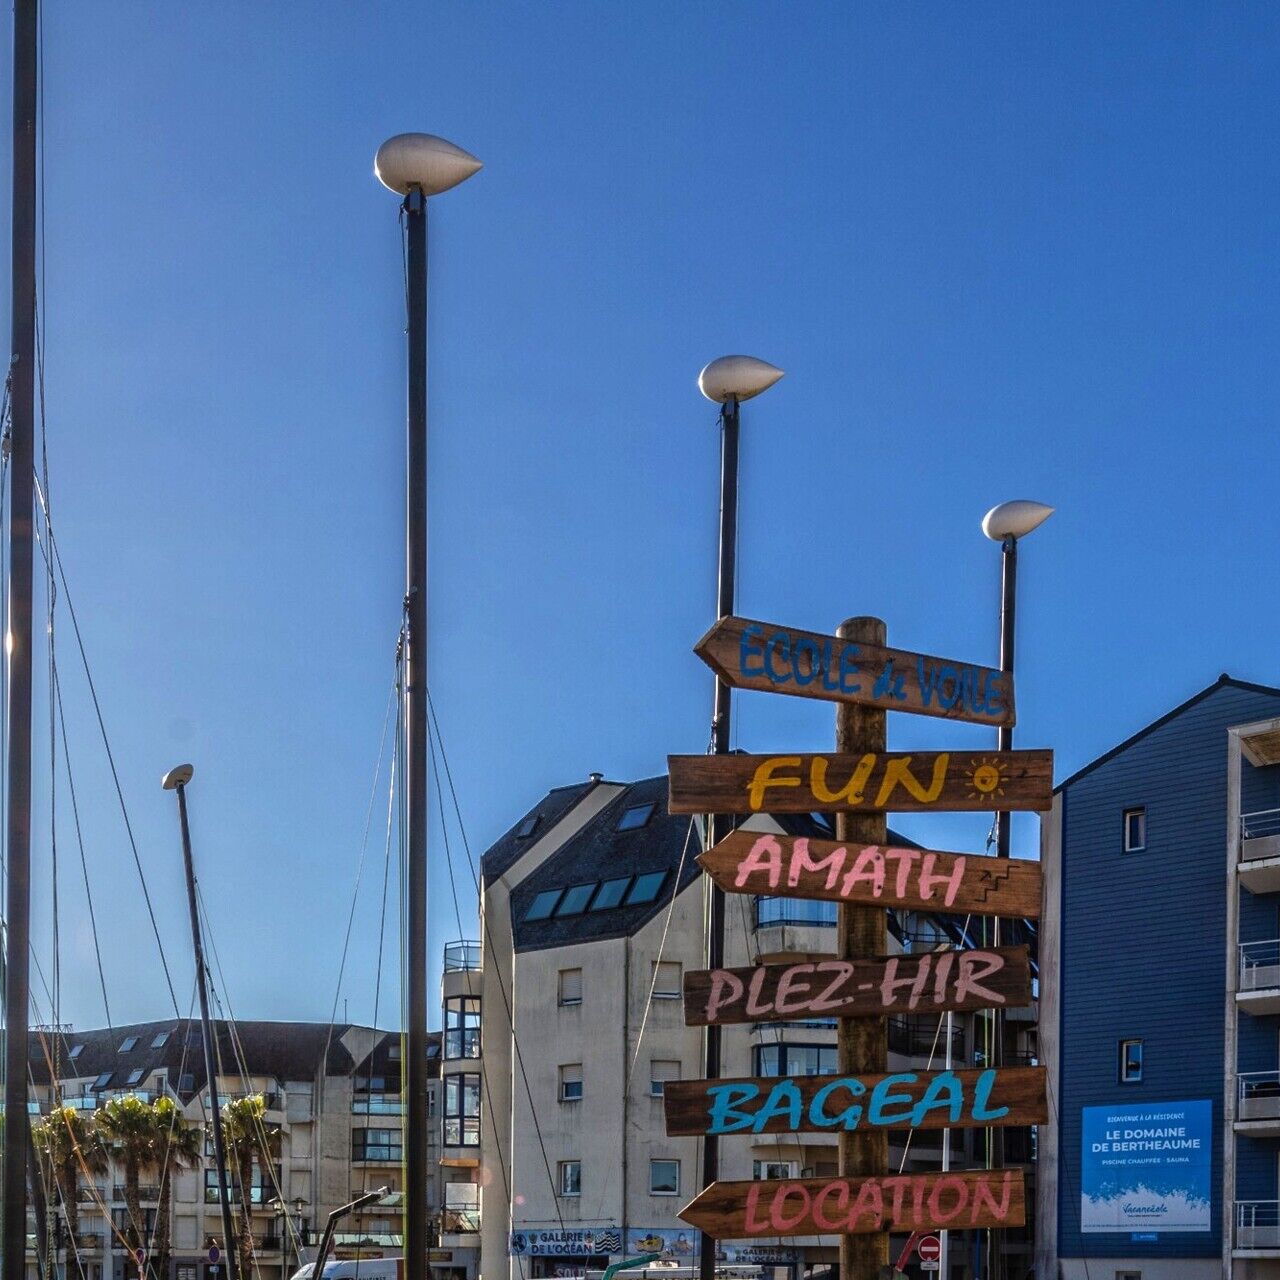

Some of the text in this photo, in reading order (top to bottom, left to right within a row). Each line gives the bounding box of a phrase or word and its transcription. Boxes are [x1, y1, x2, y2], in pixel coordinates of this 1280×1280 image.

[872, 657, 908, 701] de
[916, 655, 1005, 717] VOILE
[746, 753, 950, 810] FUN
[735, 834, 966, 907] AMATH
[705, 947, 1006, 1021] PLEZ-HIR
[706, 1068, 1010, 1134] BAGEAL
[1092, 1139, 1201, 1152] DE BERTHEAUME
[1106, 1127, 1186, 1140] LE DOMAINE
[744, 1171, 1013, 1233] LOCATION
[532, 1243, 592, 1255] DE L'OCÉAN
[540, 1233, 583, 1242] GALERIE
